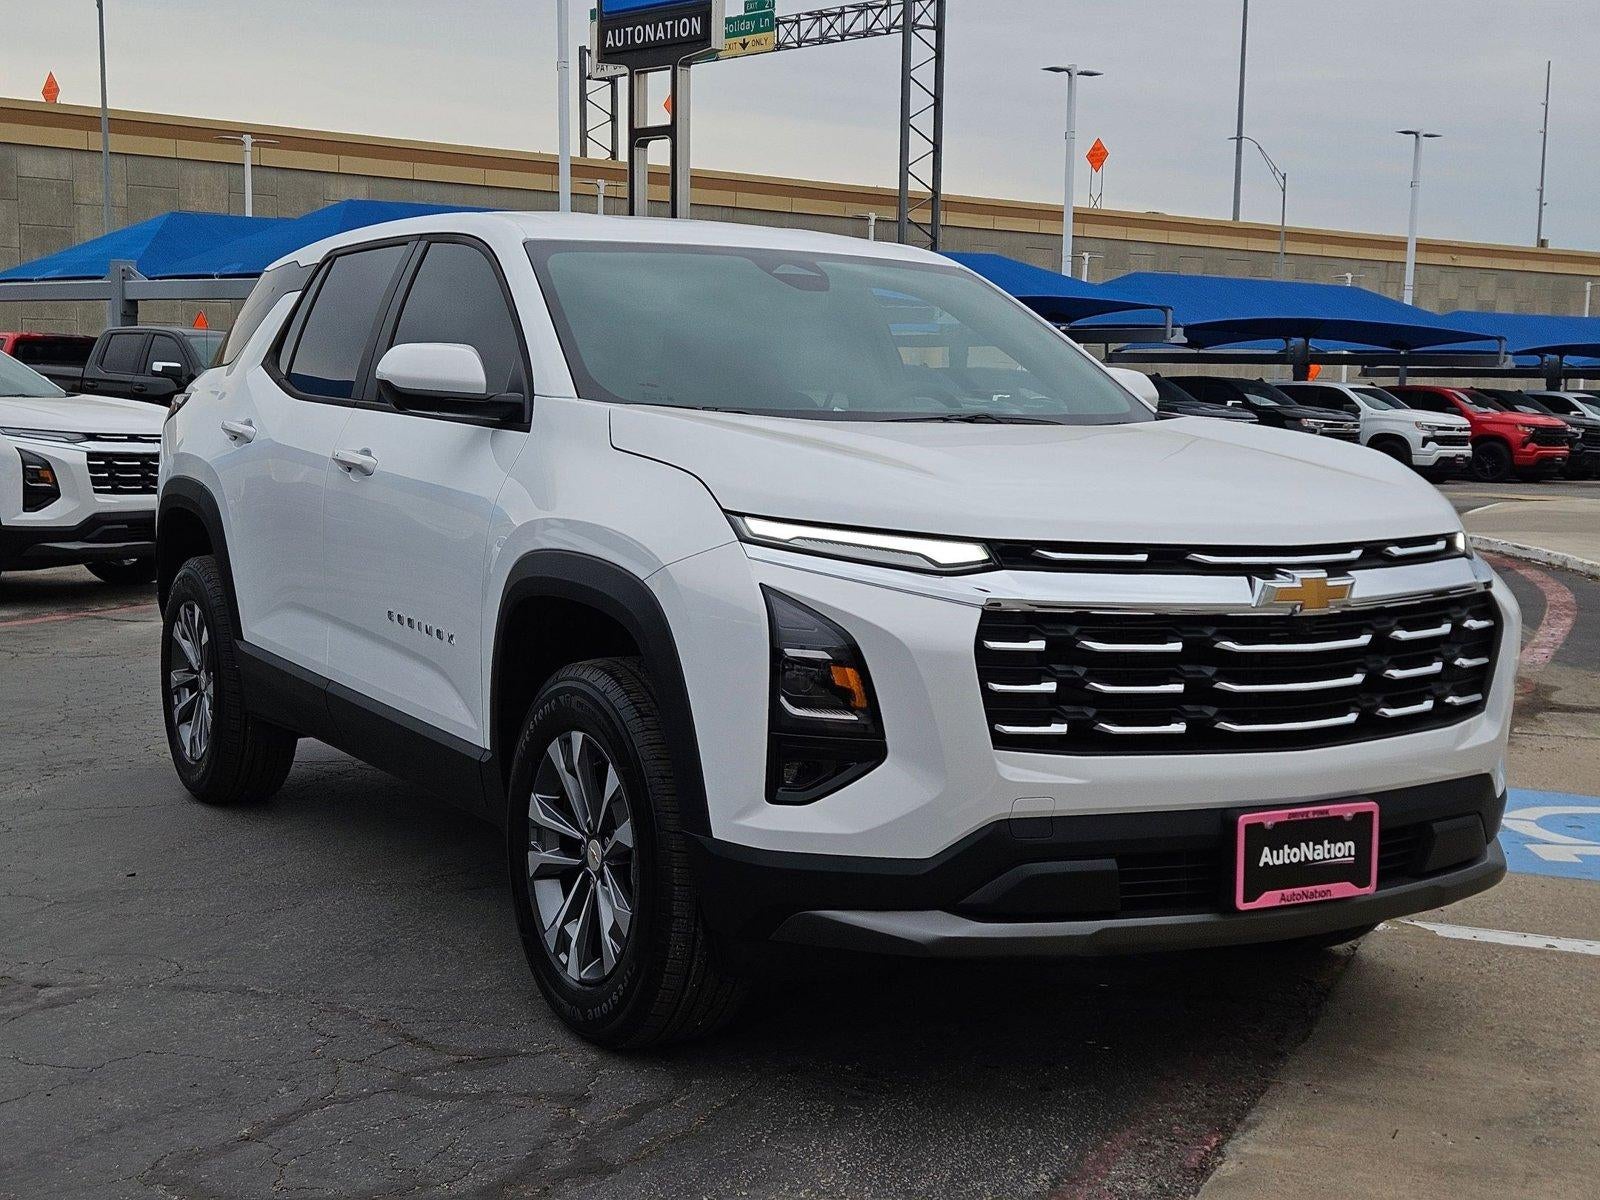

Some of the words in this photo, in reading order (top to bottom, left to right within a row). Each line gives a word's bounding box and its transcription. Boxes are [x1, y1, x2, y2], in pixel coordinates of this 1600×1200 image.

[605, 16, 701, 48] AUTONATION
[724, 19, 755, 33] Holiday
[760, 17, 770, 28] Ln
[751, 37, 769, 47] ONLY
[1258, 839, 1356, 868] AutoNation
[1278, 888, 1332, 904] AutoNation
